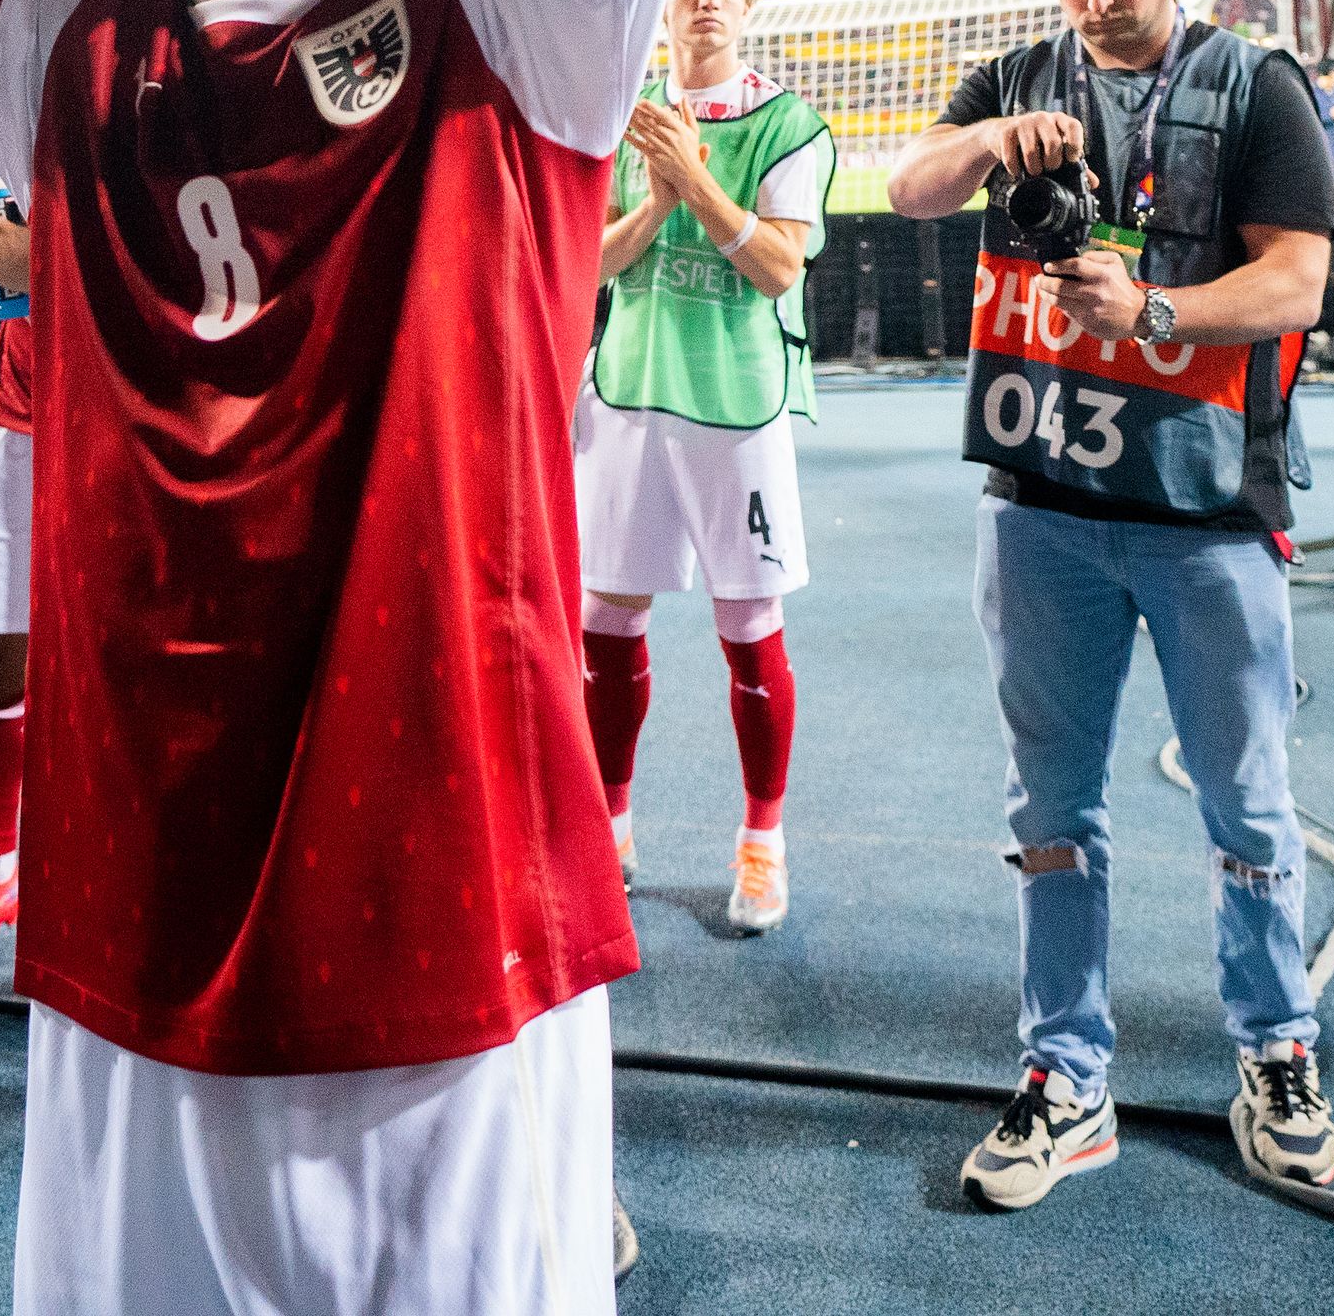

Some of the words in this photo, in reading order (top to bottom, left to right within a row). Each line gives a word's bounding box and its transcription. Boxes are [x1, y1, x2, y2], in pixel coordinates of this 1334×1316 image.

[176, 175, 260, 342] 8
[983, 372, 1128, 469] 043
[746, 490, 771, 546] 4
